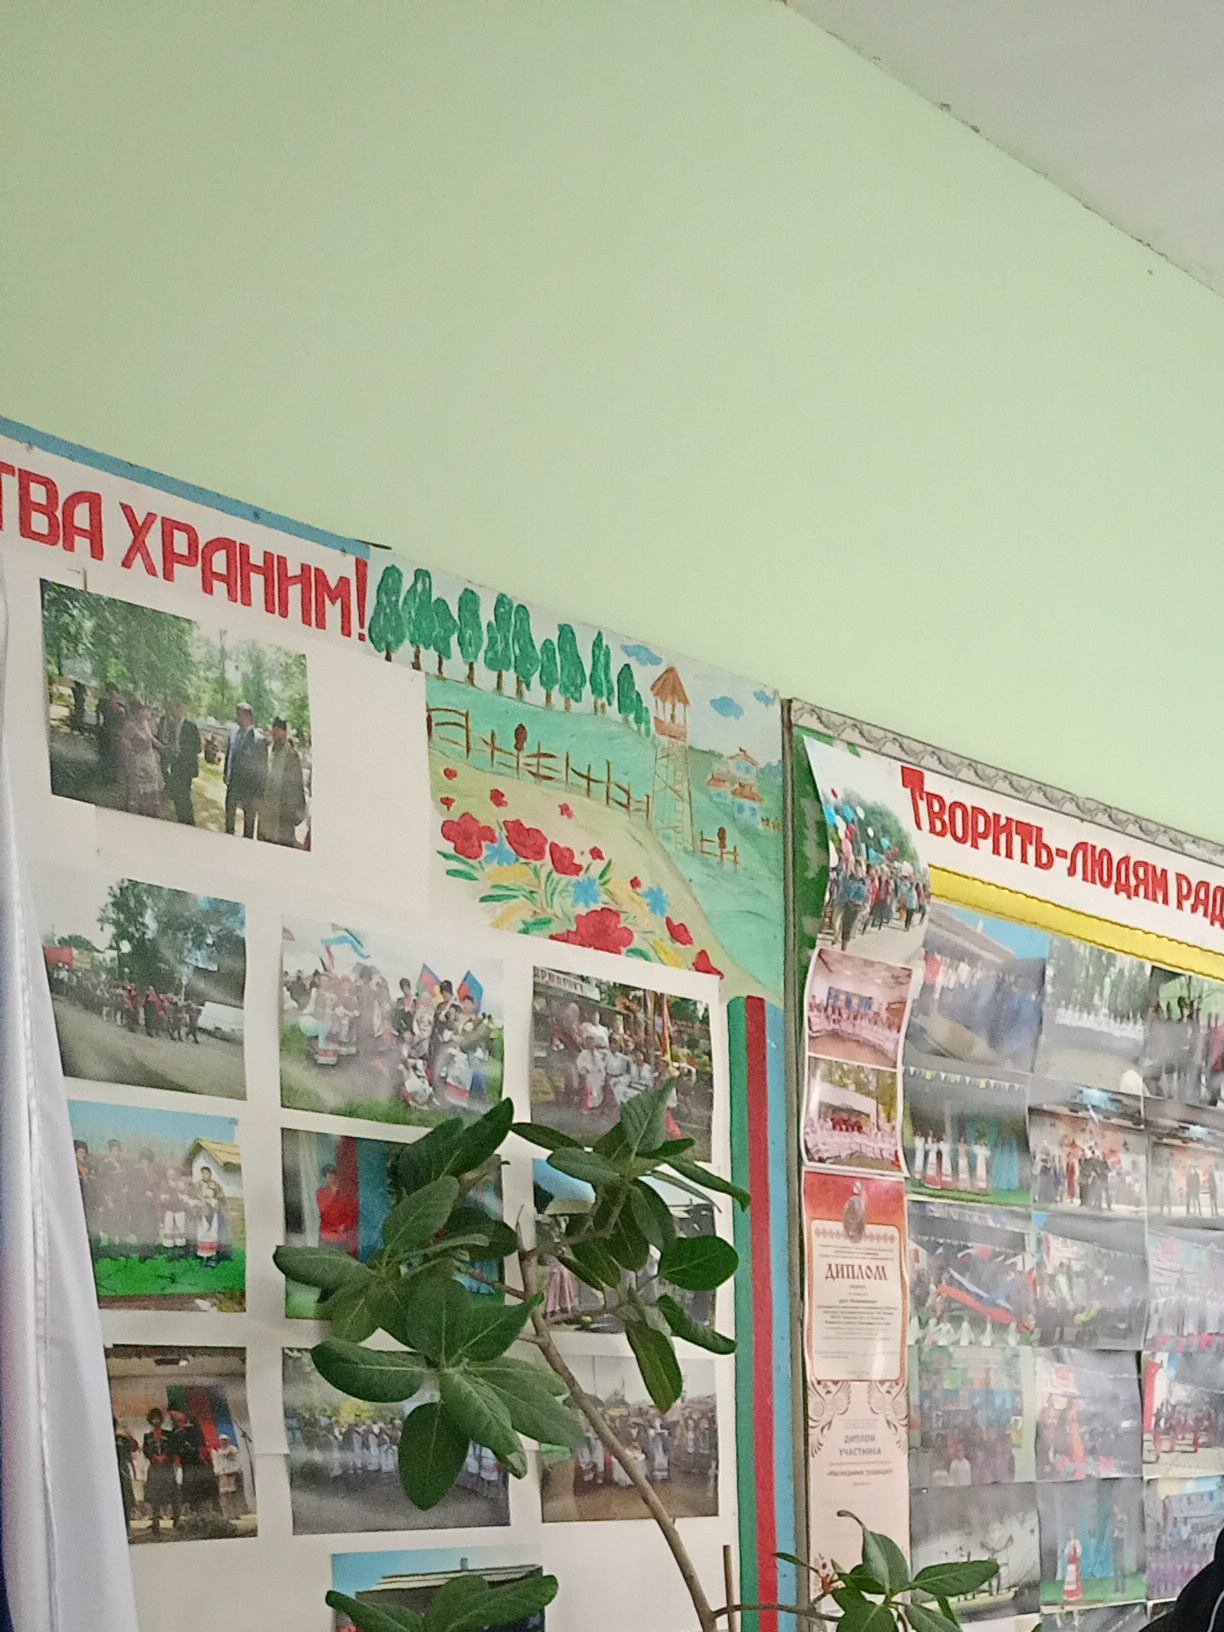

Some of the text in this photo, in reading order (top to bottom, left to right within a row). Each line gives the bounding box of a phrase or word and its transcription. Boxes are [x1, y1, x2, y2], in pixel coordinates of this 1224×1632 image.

[118, 501, 369, 643] ХРАНИМ!
[824, 1262, 889, 1282] ДИПЛОМ
[844, 1434, 877, 1444] ДИПЛОМ
[838, 1447, 883, 1457] УЧАСТНИКА
